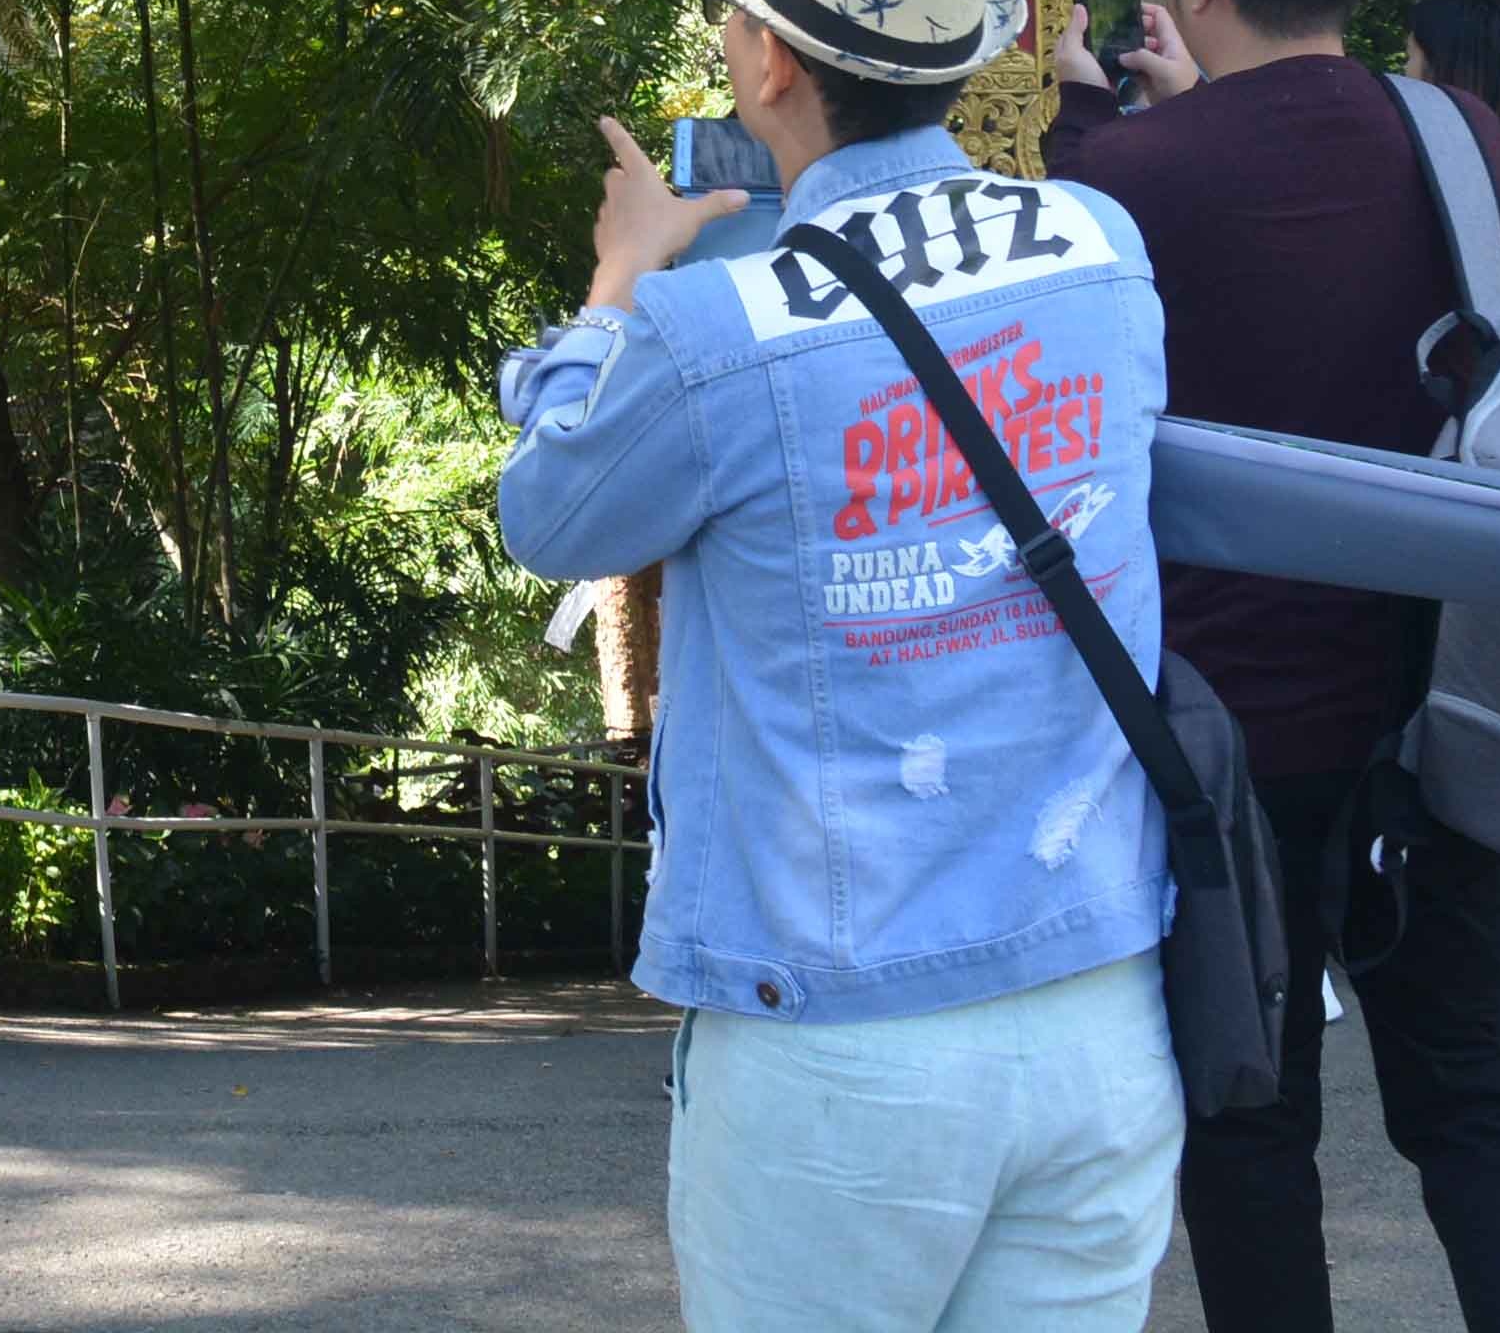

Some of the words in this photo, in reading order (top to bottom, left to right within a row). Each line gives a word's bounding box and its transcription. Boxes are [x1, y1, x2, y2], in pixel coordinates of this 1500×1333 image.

[887, 396, 1103, 526] PIRTES!
[832, 541, 943, 582] PURNA
[823, 573, 955, 614] UNDEAD
[938, 608, 998, 634] SUNDAY
[869, 651, 892, 668] AT
